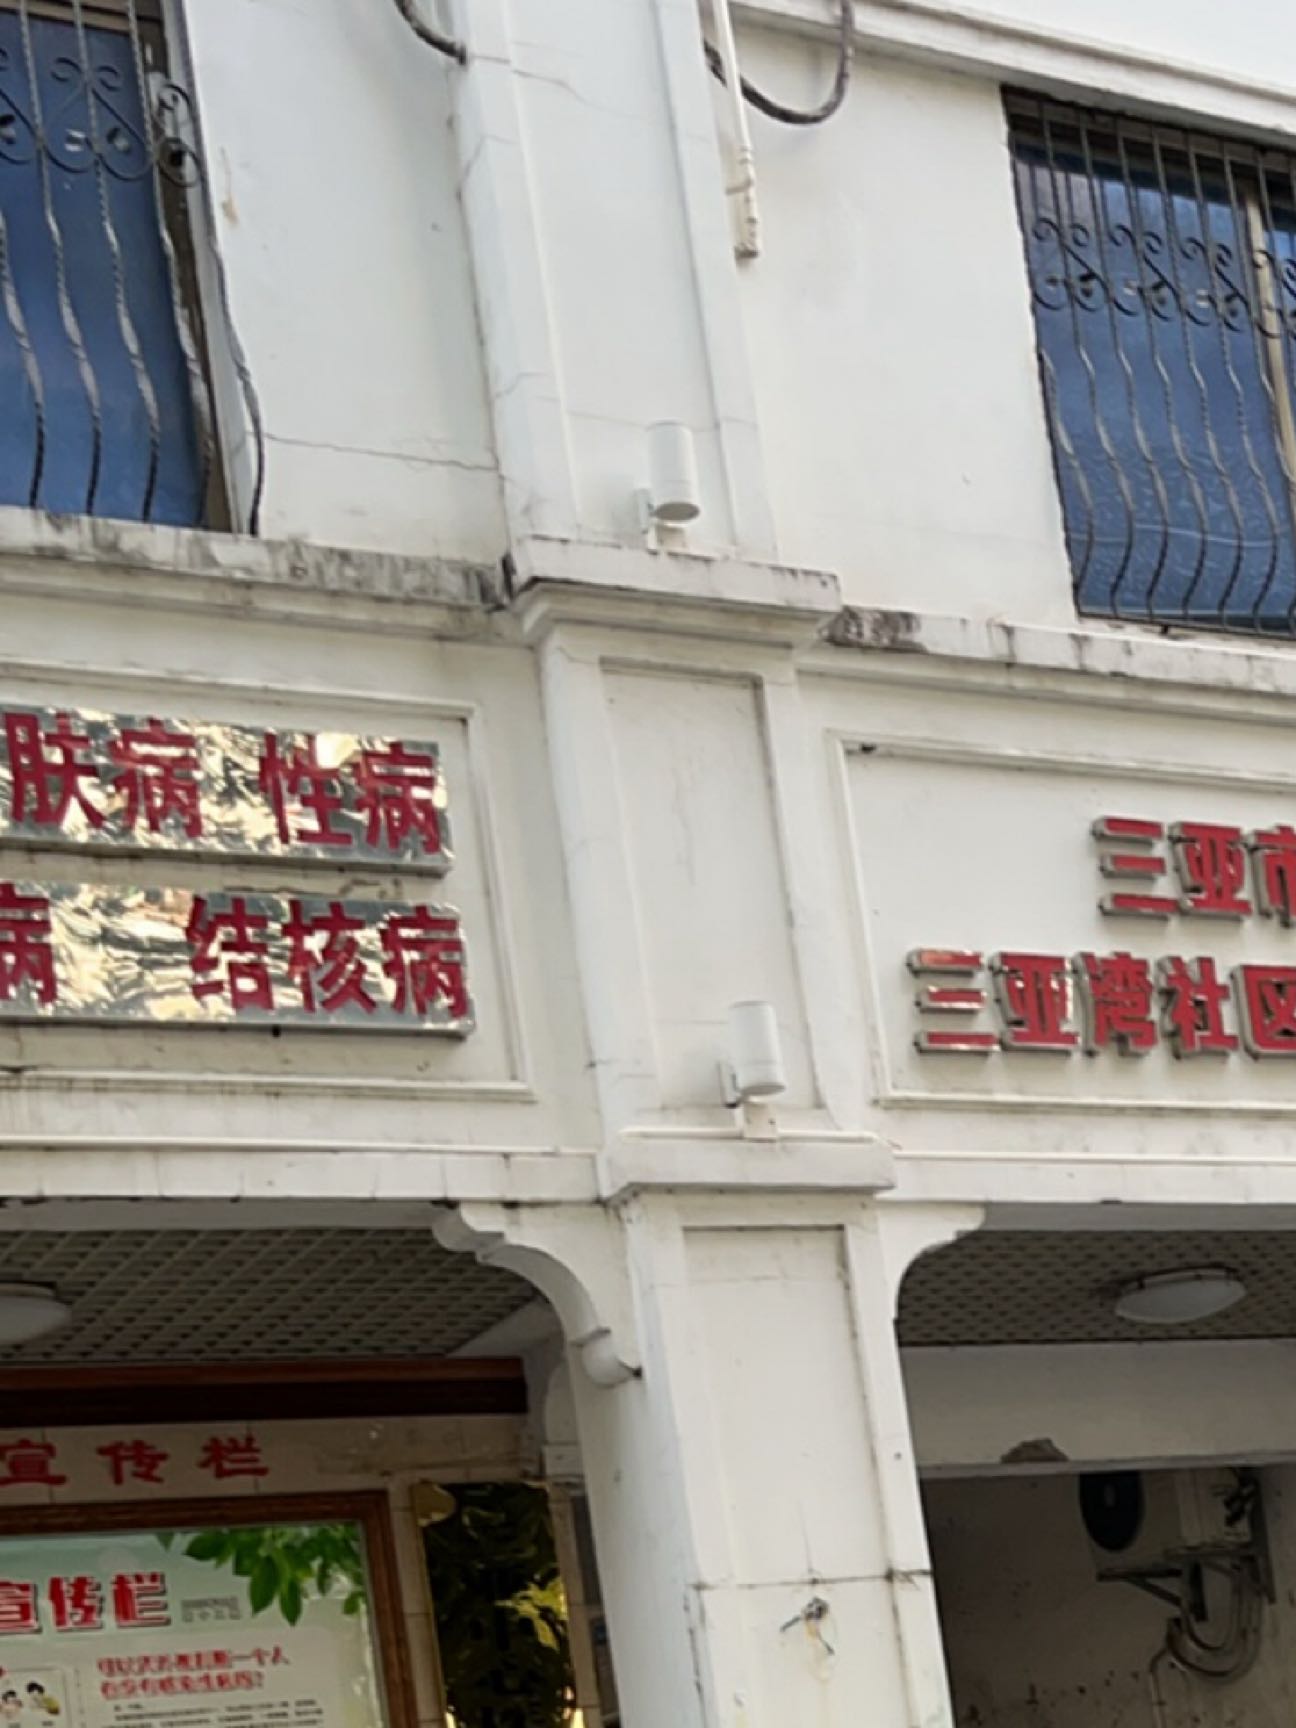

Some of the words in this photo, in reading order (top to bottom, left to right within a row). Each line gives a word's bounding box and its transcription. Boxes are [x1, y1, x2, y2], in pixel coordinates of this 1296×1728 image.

[5, 711, 201, 839] 肤病
[259, 727, 441, 853] 性病
[186, 896, 470, 1018] 结核病
[0, 1435, 269, 1488] 宣传栏
